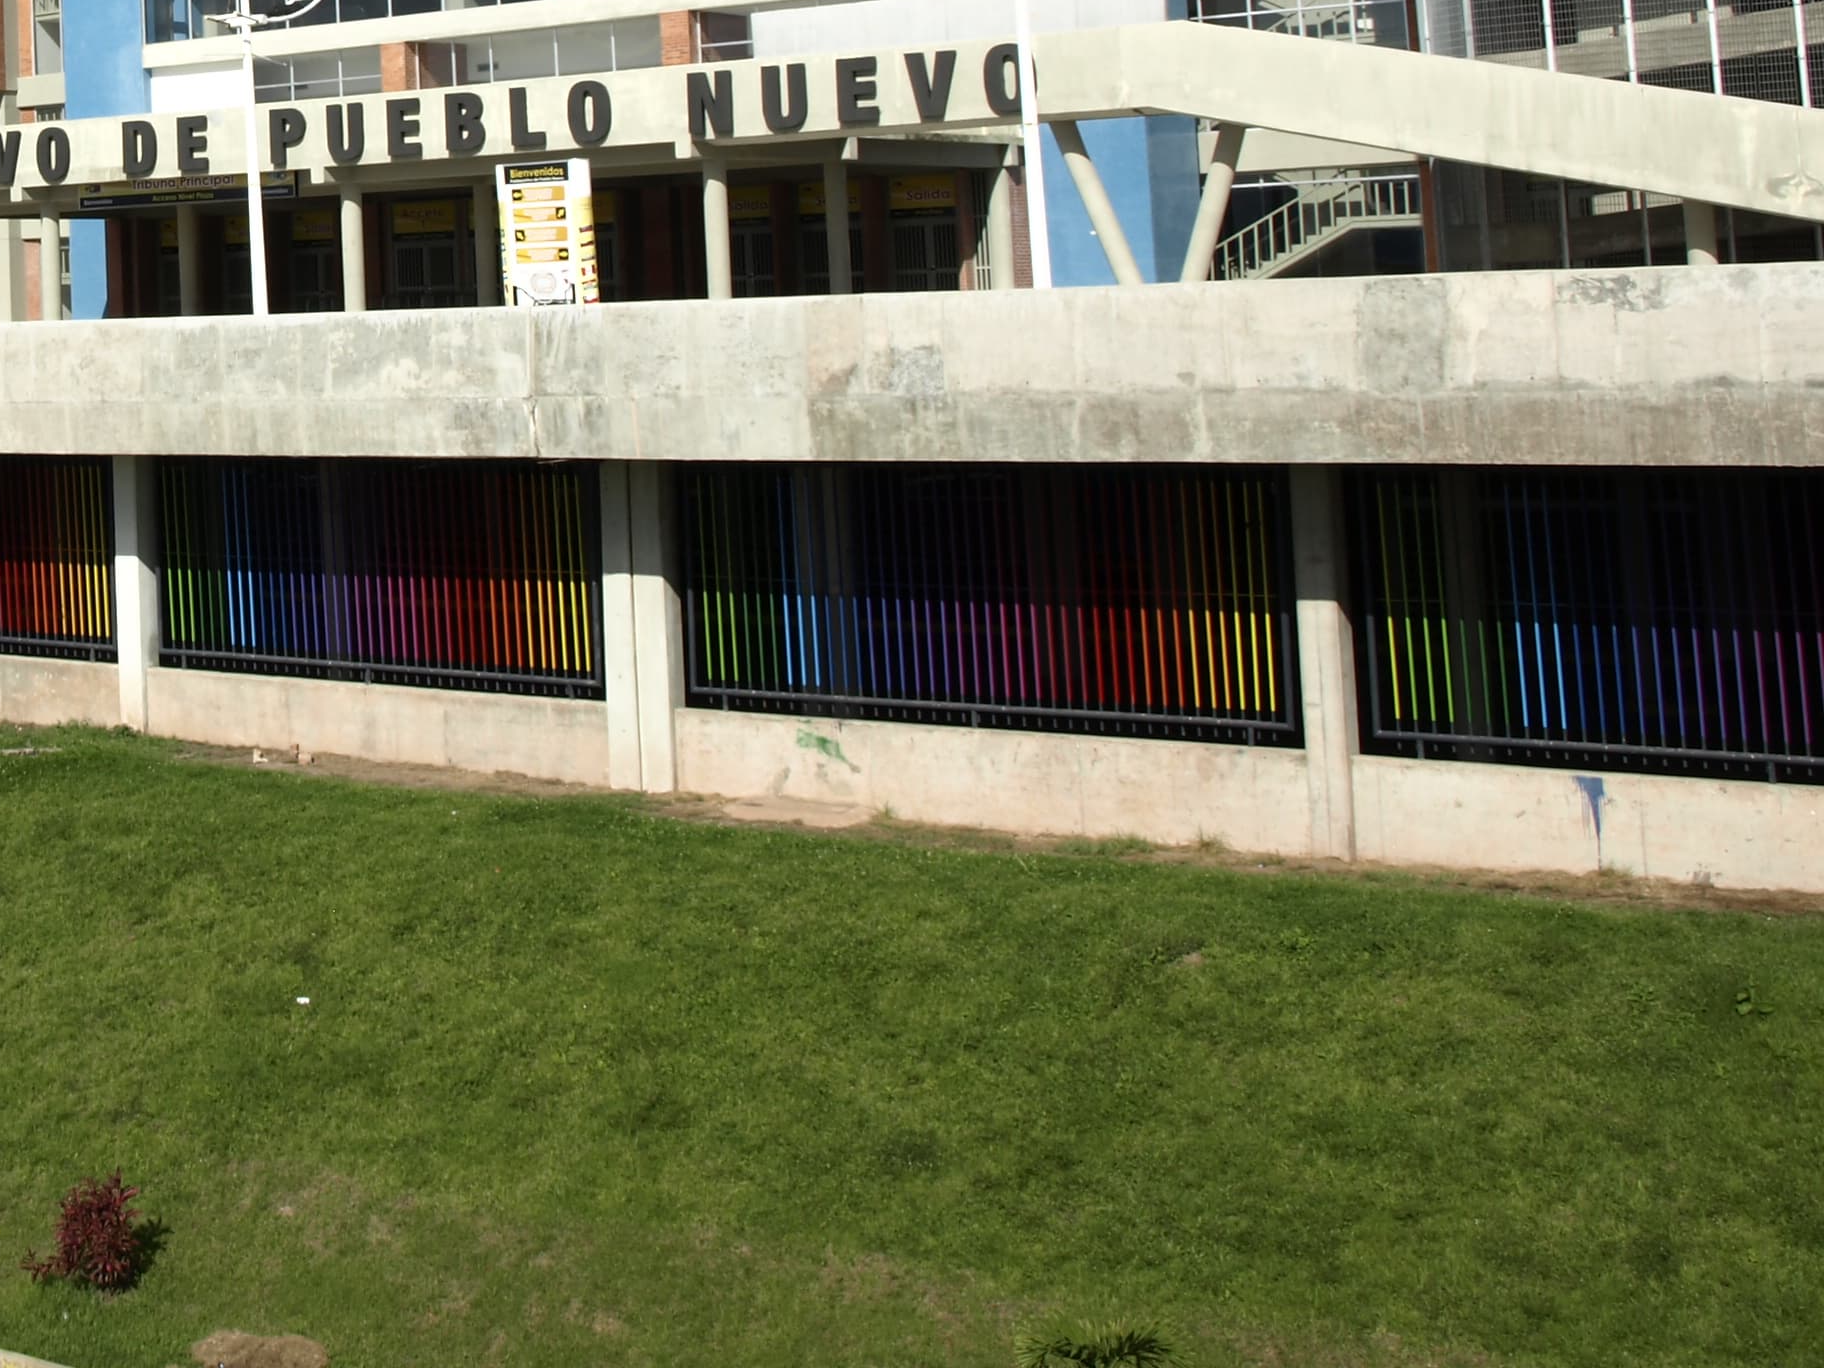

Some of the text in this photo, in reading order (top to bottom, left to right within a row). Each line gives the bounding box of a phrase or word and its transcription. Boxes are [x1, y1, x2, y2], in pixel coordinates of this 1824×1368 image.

[121, 115, 209, 176] DE
[269, 79, 612, 166] PUEBLO
[686, 43, 1037, 136] NUEVO
[509, 166, 564, 178] Bienvenidos
[132, 174, 234, 190] Tribuna Principal
[906, 189, 951, 201] Salida
